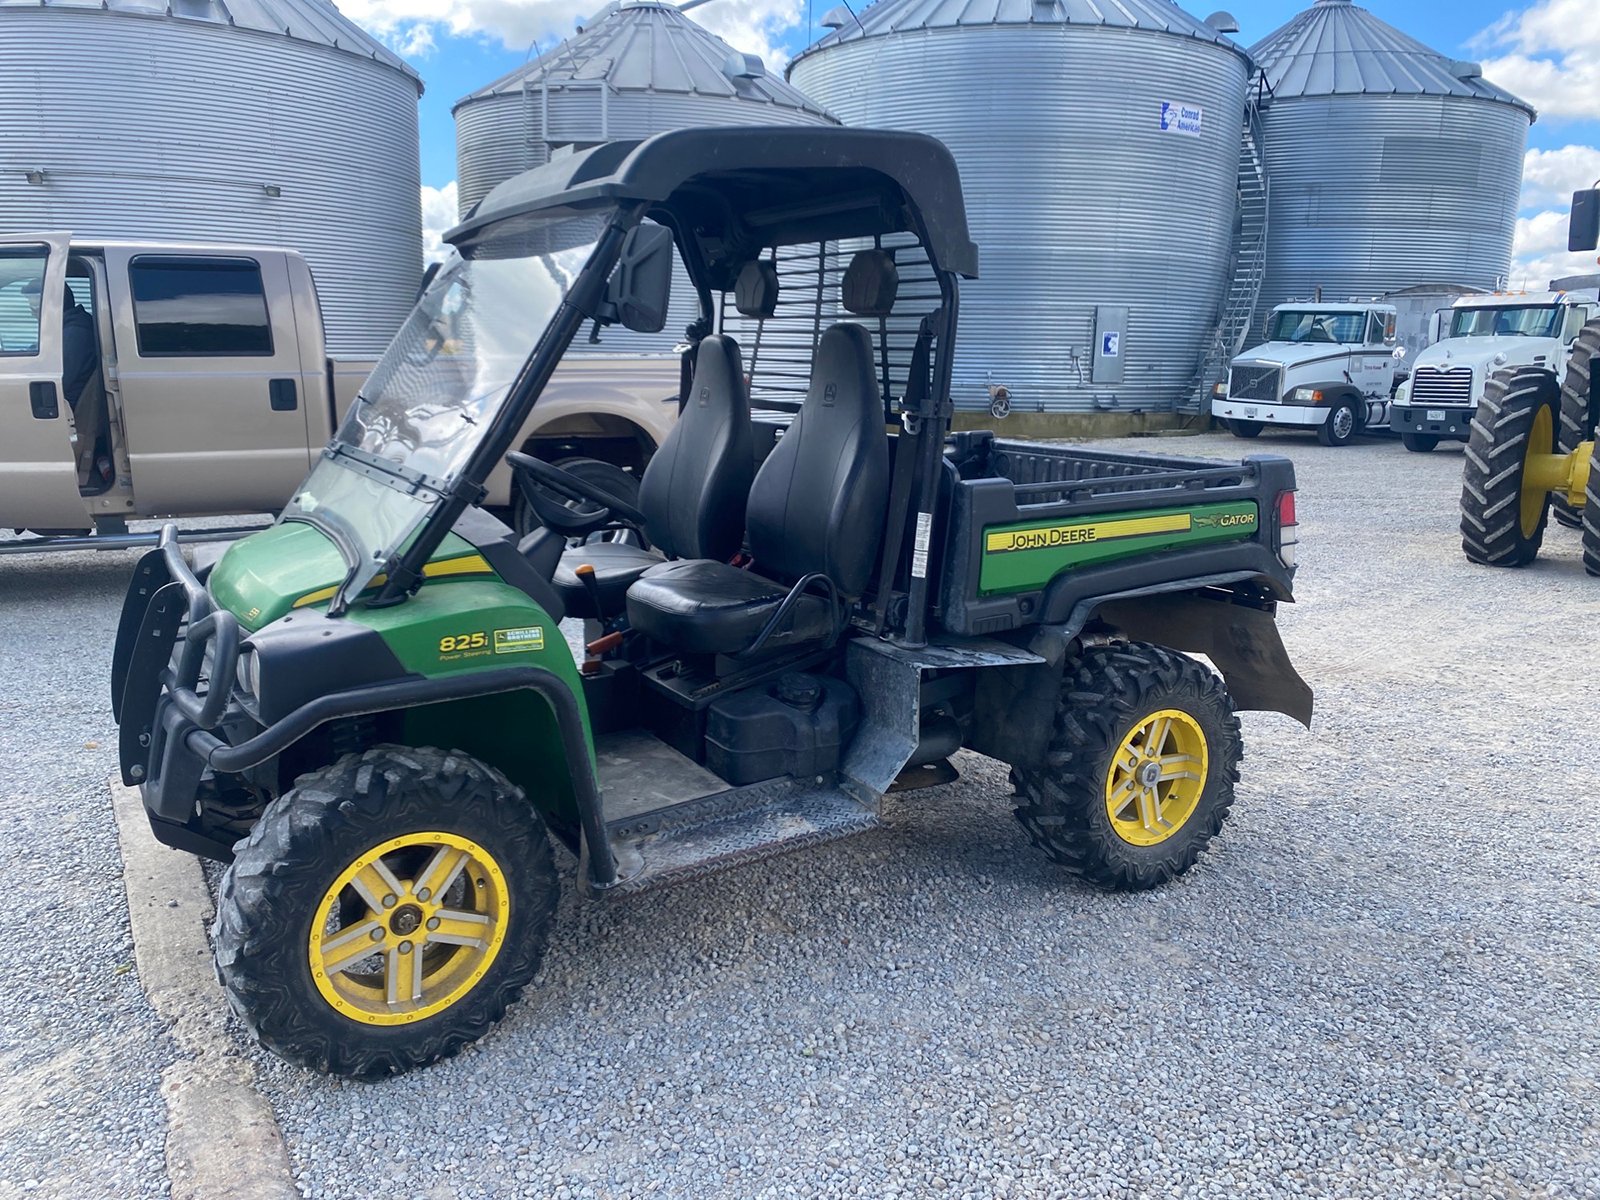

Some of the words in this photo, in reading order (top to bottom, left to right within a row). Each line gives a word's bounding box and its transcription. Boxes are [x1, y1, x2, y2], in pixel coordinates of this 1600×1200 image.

[1181, 107, 1199, 120] Conrad
[1177, 120, 1200, 133] American
[1221, 514, 1255, 526] GATOR
[1007, 533, 1047, 549] JOHN
[1050, 528, 1096, 544] DEERE
[440, 632, 489, 652] 825i
[463, 650, 492, 658] Steering
